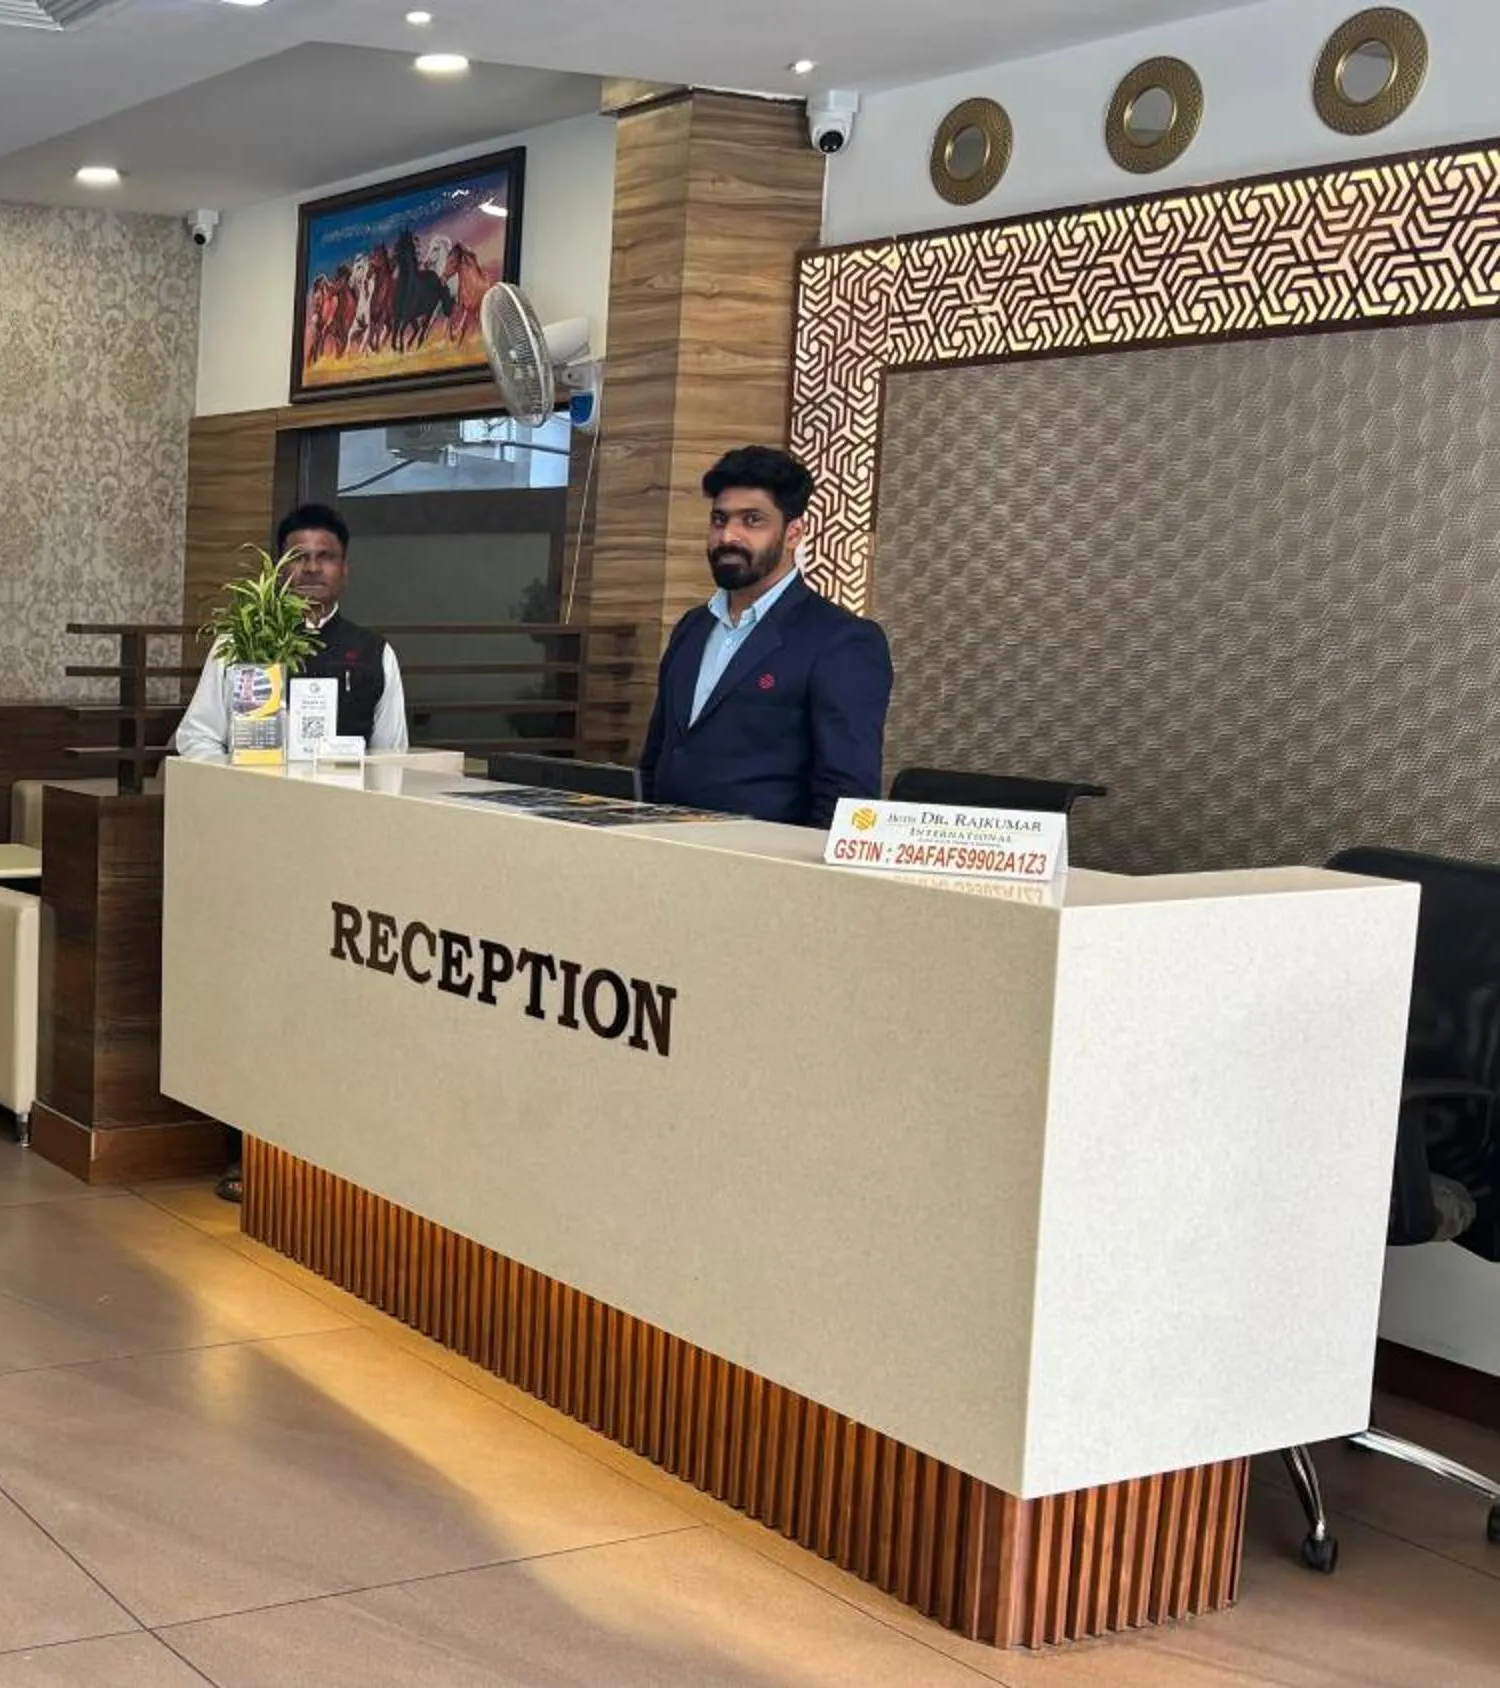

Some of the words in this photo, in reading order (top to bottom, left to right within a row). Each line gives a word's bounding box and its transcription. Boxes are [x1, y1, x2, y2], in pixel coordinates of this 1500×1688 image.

[955, 813, 1042, 833] RAJKUMAR
[909, 827, 1013, 844] INTERNATIONAL
[834, 838, 883, 861] GSTIN
[329, 901, 678, 1057] RECEPTION
